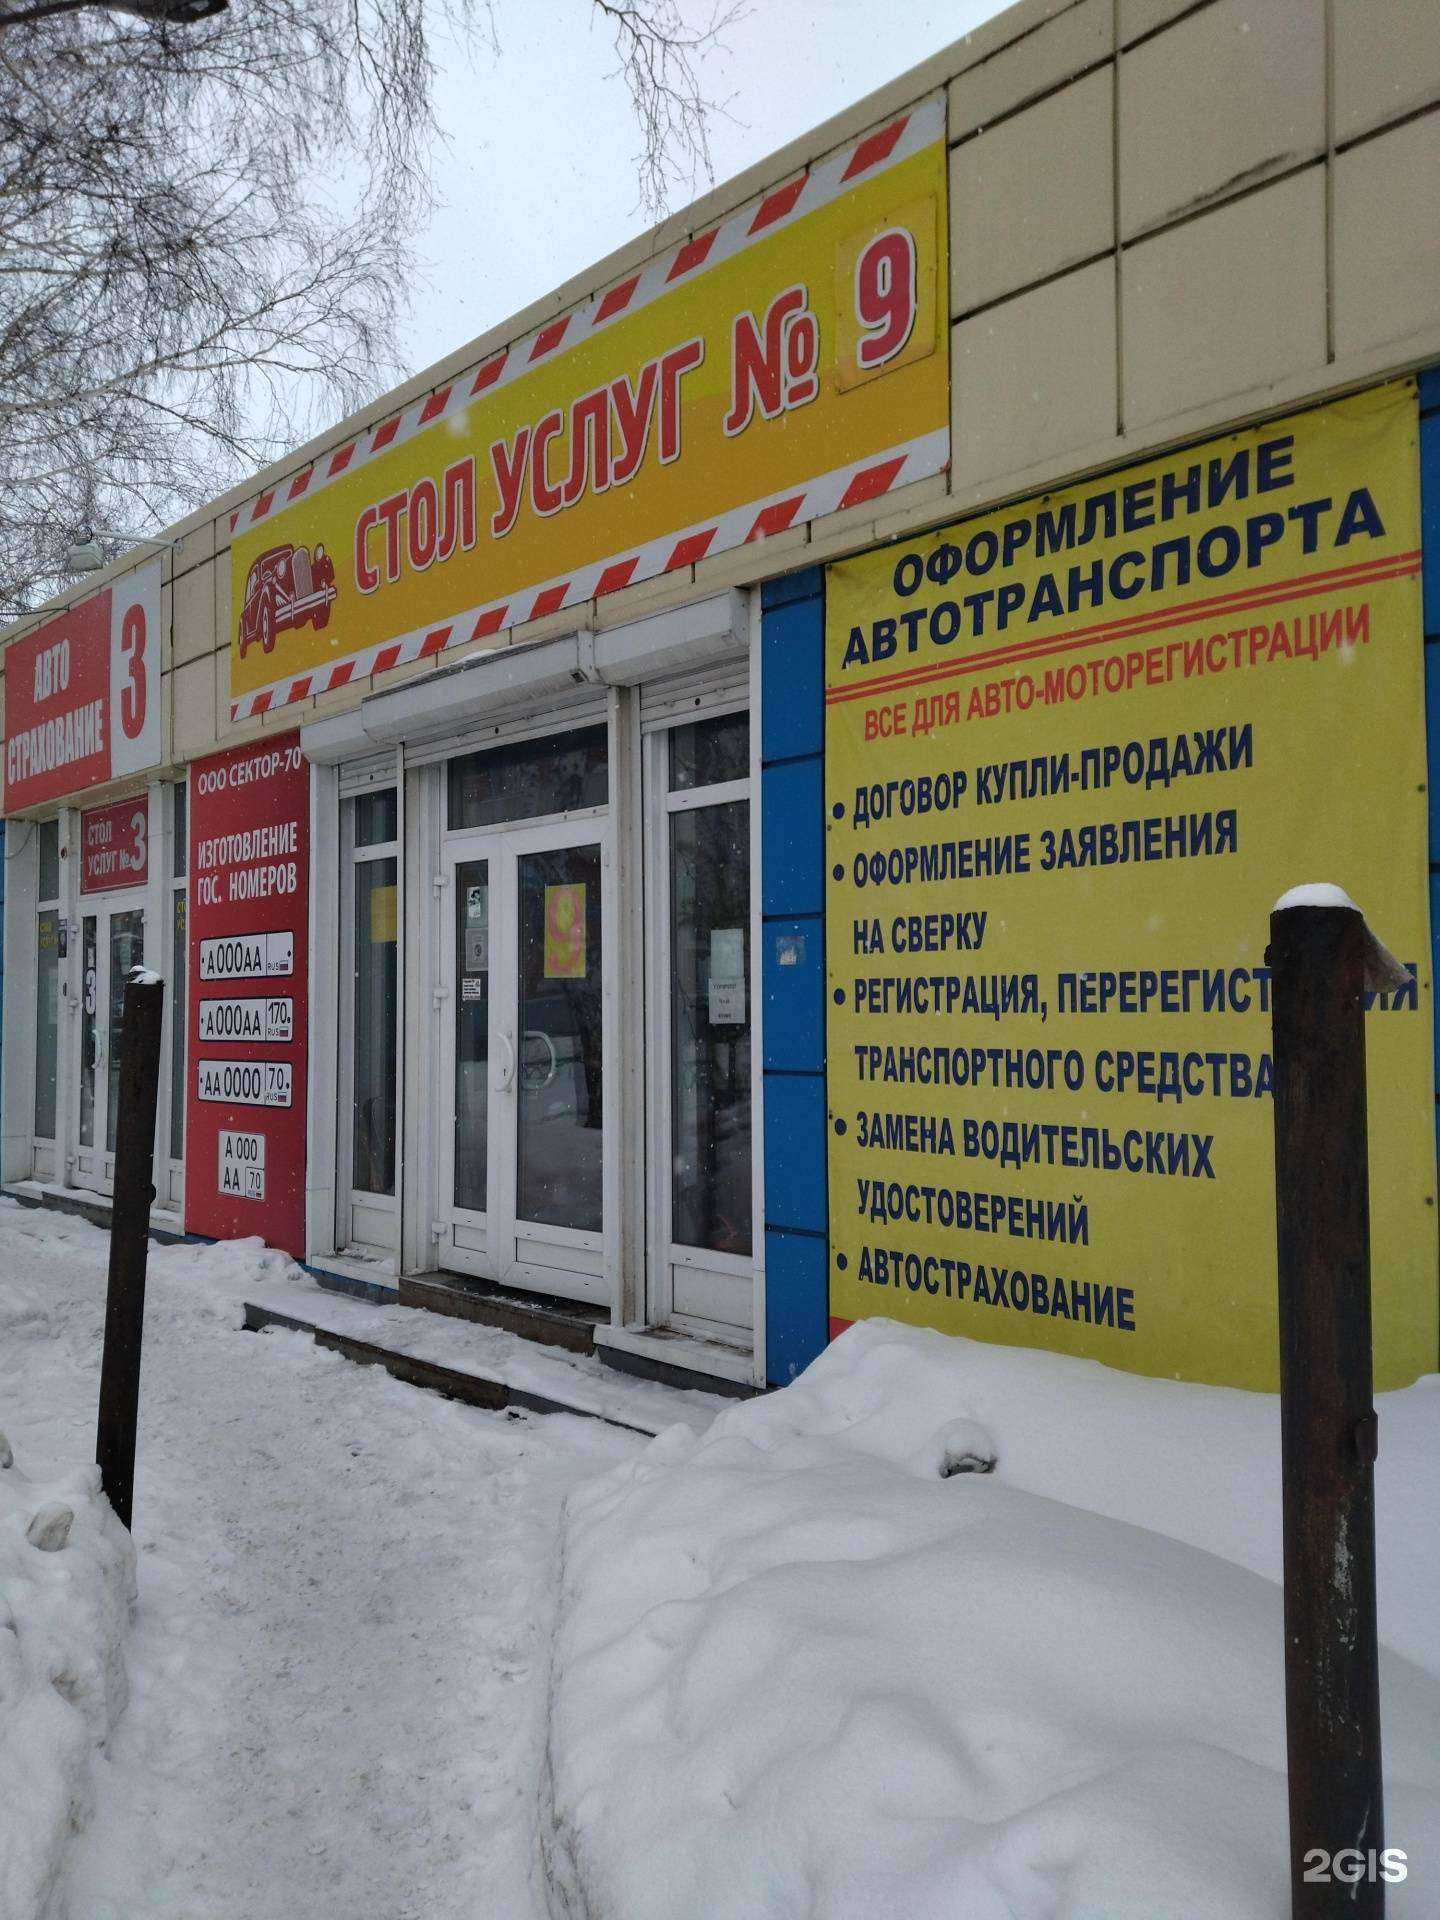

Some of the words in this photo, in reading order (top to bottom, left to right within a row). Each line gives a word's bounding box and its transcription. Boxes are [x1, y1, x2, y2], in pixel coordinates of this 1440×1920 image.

[355, 456, 476, 594] СТОЛ
[491, 337, 705, 540] УСЛУГ
[723, 283, 819, 437] №
[854, 227, 916, 370] 9
[893, 435, 1295, 597] ОФОРМЛЕНИЕ
[841, 487, 1386, 669] АВТОТРАНСПОРТА
[34, 638, 70, 703] АВТО
[120, 603, 147, 740] 3
[865, 702, 907, 741] ВСЕ
[912, 692, 960, 738] ДЛЯ
[966, 603, 1370, 721] АВТО-МОТОРЕГИСТРАЦИИ
[7, 698, 104, 786] СТРАХОВАНИЕ
[198, 768, 226, 796] ООО
[229, 746, 301, 788] СЕКТОР-70
[853, 770, 967, 829] ДОГОВОР
[976, 723, 1253, 806] КУПЛИ-ПРОДАЖИ
[88, 820, 112, 847] СТОЛ
[88, 850, 118, 877] УСЛУГ
[131, 811, 146, 871] 3
[198, 821, 298, 870] ИЗГОТОВЛЕНИЕ
[853, 831, 1031, 887] ОФОРМЛЕНИЕ
[1040, 809, 1238, 872] ЗАЯВЛЕНИЯ
[197, 875, 222, 906] ГОС.
[229, 862, 297, 901] НОМЕРОВ
[853, 918, 884, 954] НА
[891, 911, 987, 954] СВЕРКУ
[268, 1002, 288, 1024] 170
[854, 974, 1048, 1022] РЕГИСТРАЦИЯ,
[269, 1067, 284, 1090] 70
[854, 1045, 1085, 1091] ТРАНСПОРТНОГО
[856, 1111, 955, 1156] ЗАМЕНА
[964, 1119, 1216, 1179] ВОДИТЕЛЬСКИХ
[857, 1179, 1089, 1246] УДОСТОВЕРЕНИЙ
[858, 1246, 1136, 1332] АВТОСТРАХОВАНИЕ
